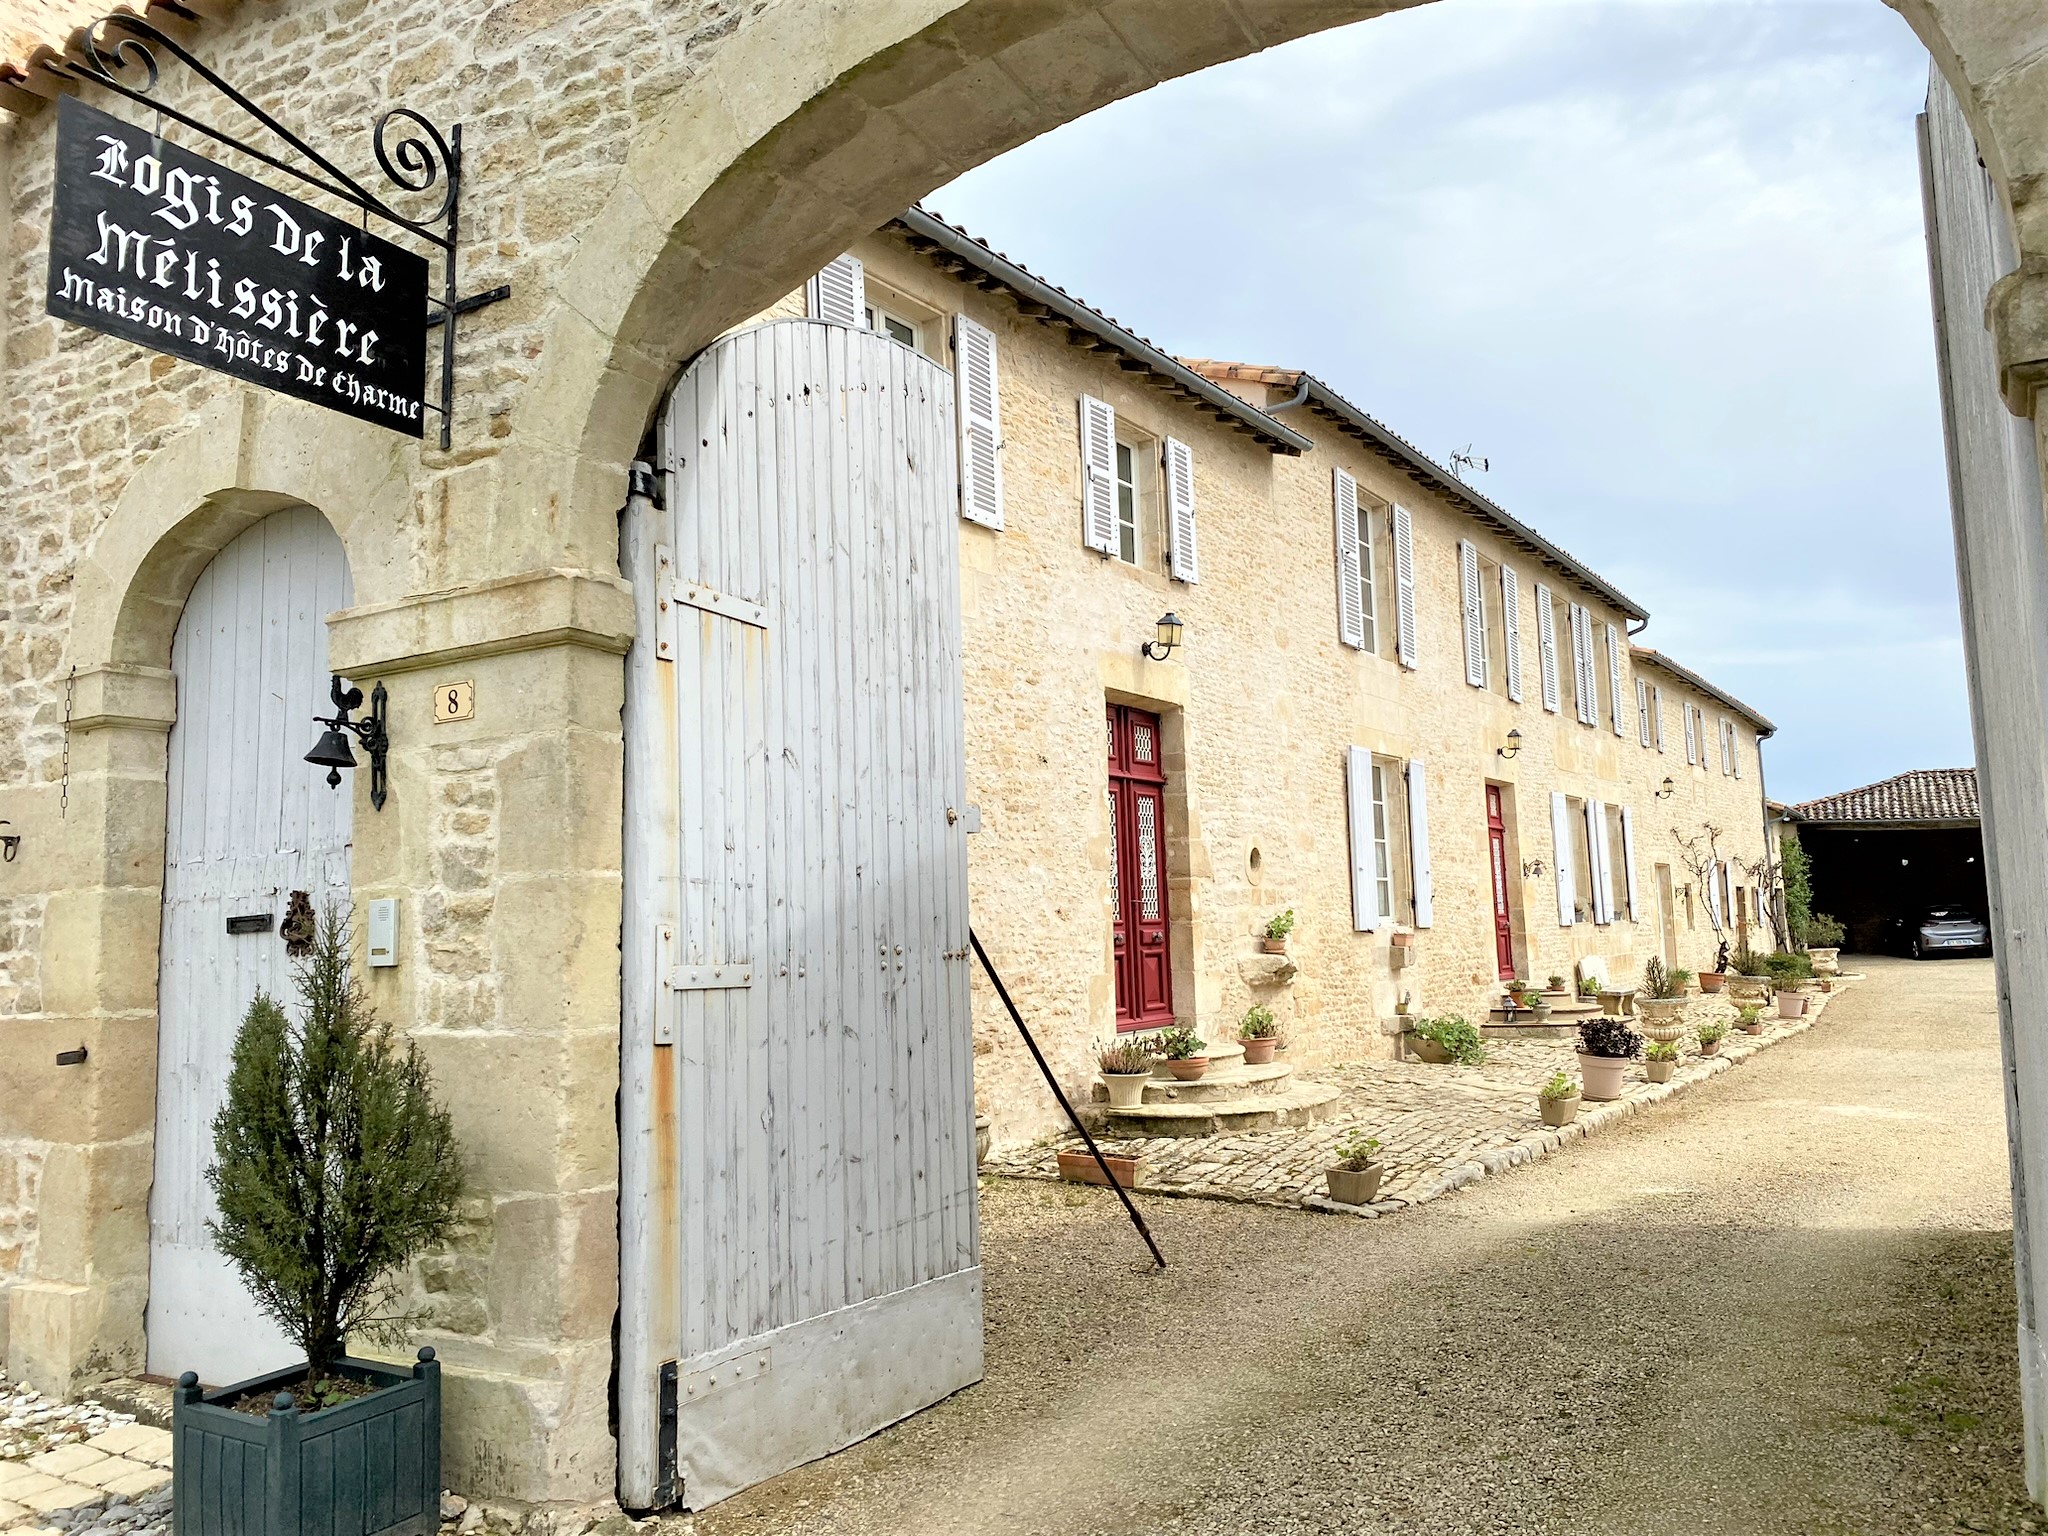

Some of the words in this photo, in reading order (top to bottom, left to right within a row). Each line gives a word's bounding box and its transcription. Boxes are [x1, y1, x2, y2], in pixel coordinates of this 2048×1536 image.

[86, 210, 380, 366] Mélissière
[90, 135, 258, 237] Logis
[336, 234, 387, 293] la
[56, 267, 183, 337] Maison
[331, 370, 420, 420] Charme
[448, 689, 459, 714] 8
